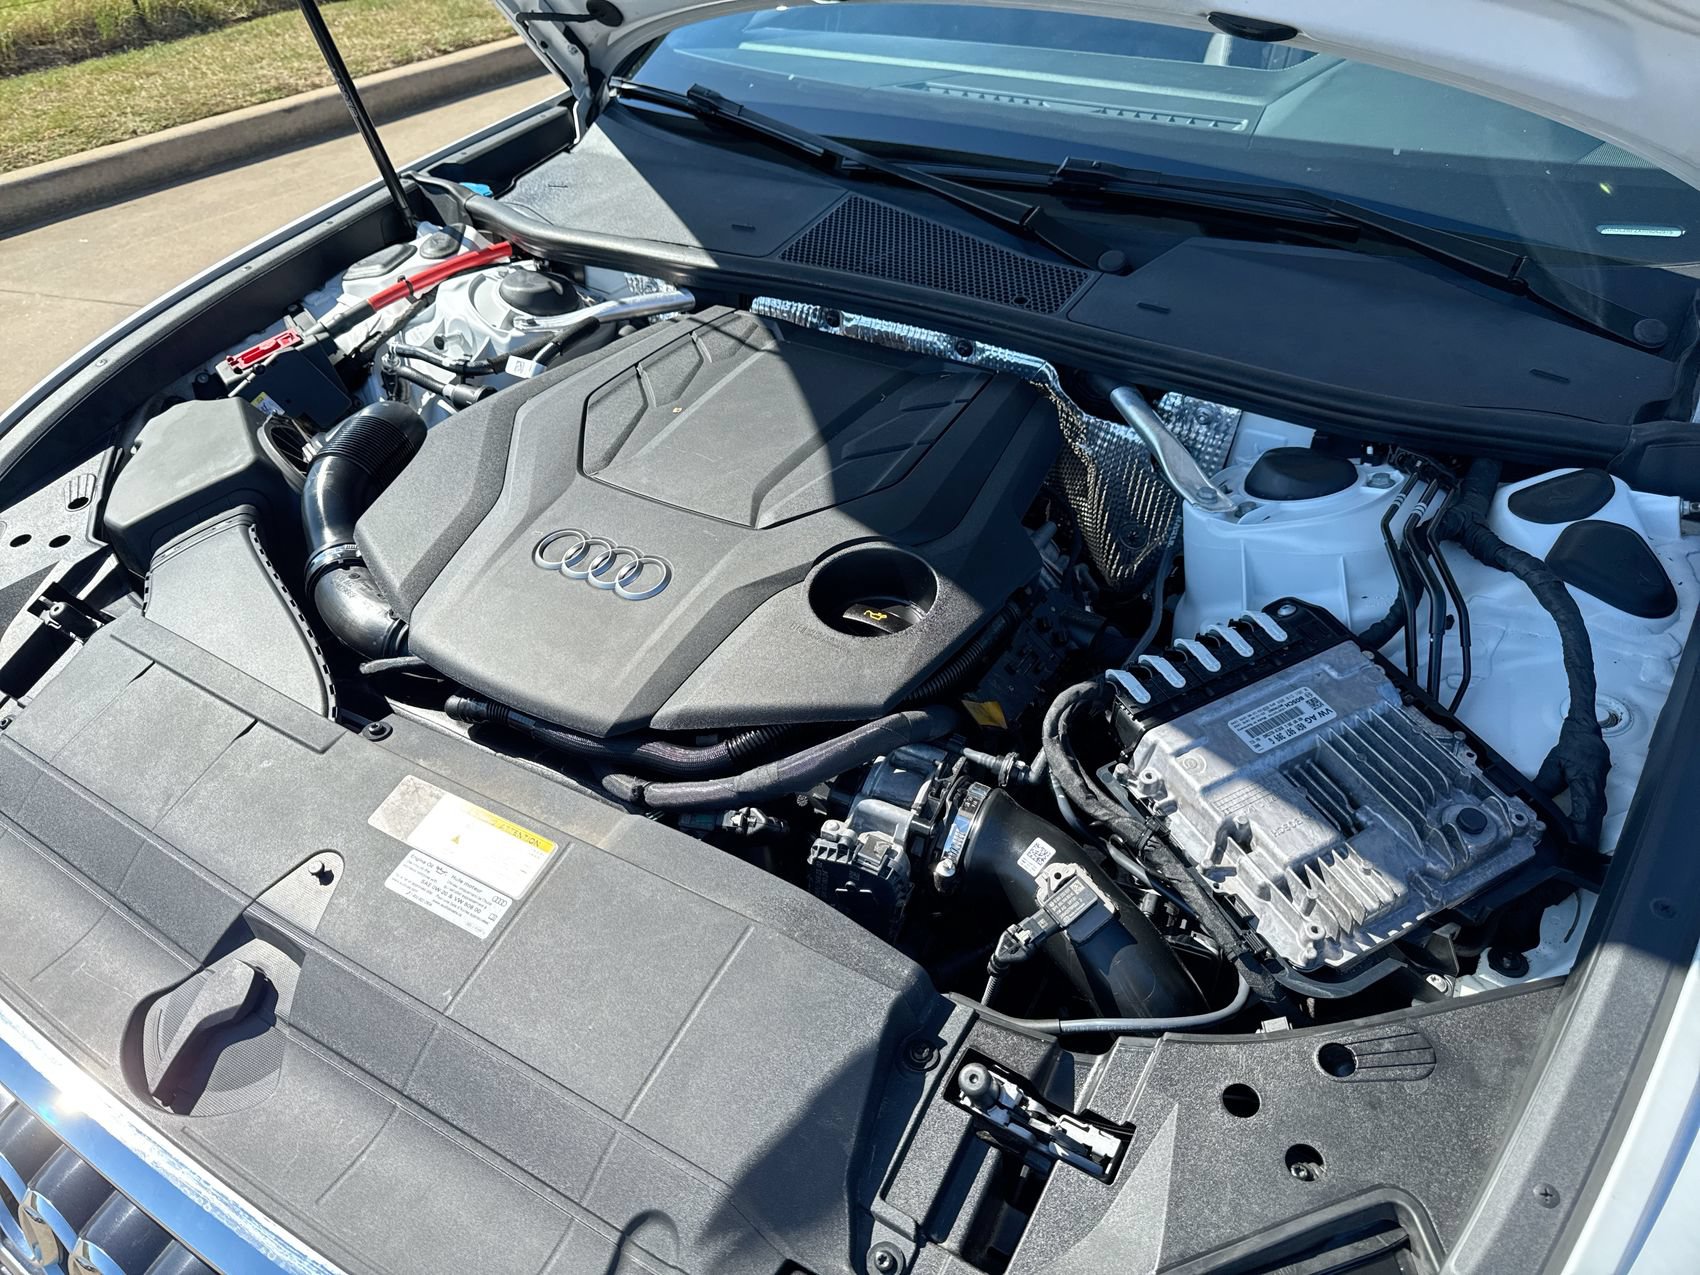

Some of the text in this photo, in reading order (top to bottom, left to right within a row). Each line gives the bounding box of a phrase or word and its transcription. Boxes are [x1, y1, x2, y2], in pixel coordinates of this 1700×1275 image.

[1284, 696, 1305, 707] BOSCH
[1318, 708, 1333, 717] VW
[1305, 714, 1318, 723] AG
[500, 823, 542, 847] ATTENTION
[410, 854, 426, 864] Engine
[451, 875, 483, 893] Huile moteur
